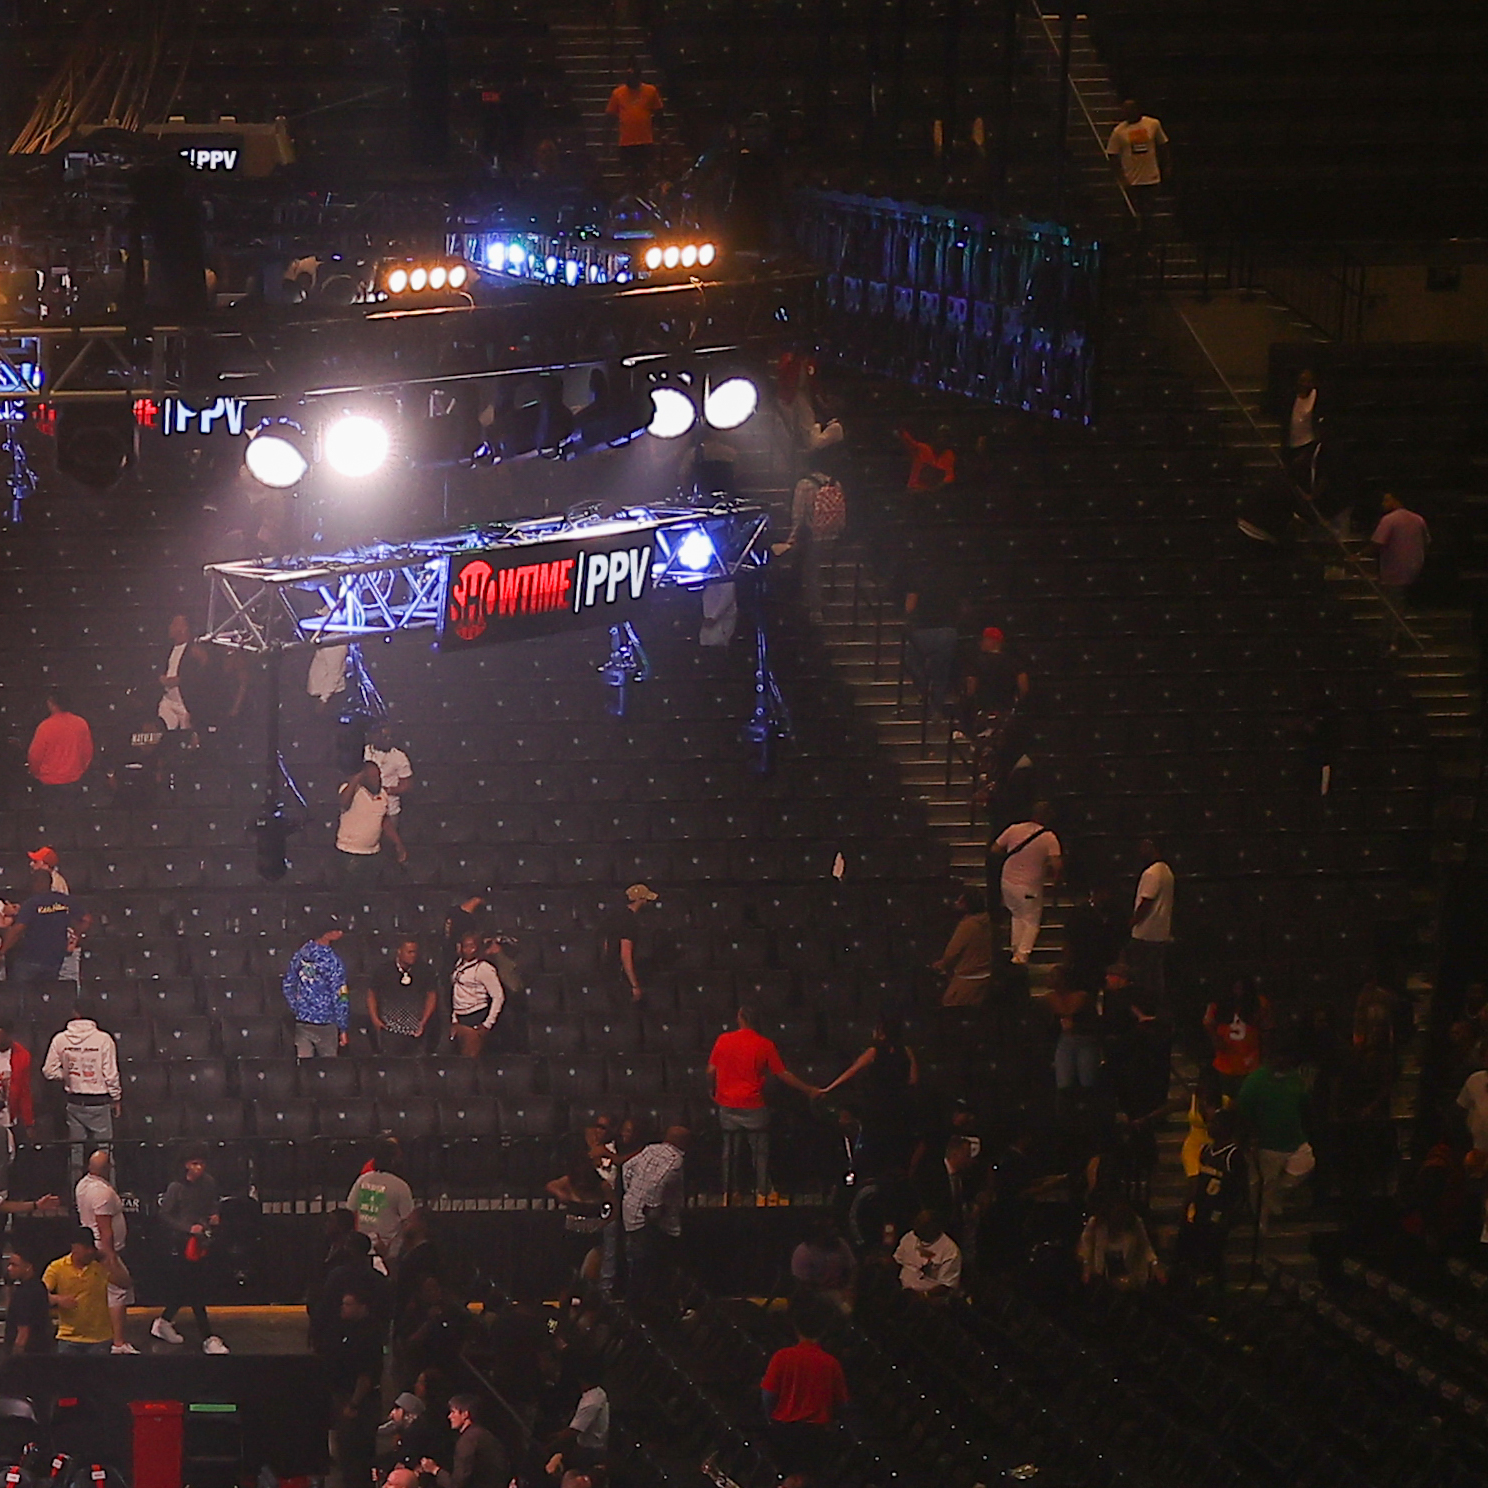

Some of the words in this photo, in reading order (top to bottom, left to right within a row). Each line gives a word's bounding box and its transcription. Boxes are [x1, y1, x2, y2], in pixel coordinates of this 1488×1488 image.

[196, 149, 238, 171] PPV
[450, 560, 576, 641] SHOWTIME
[584, 545, 652, 607] PPV
